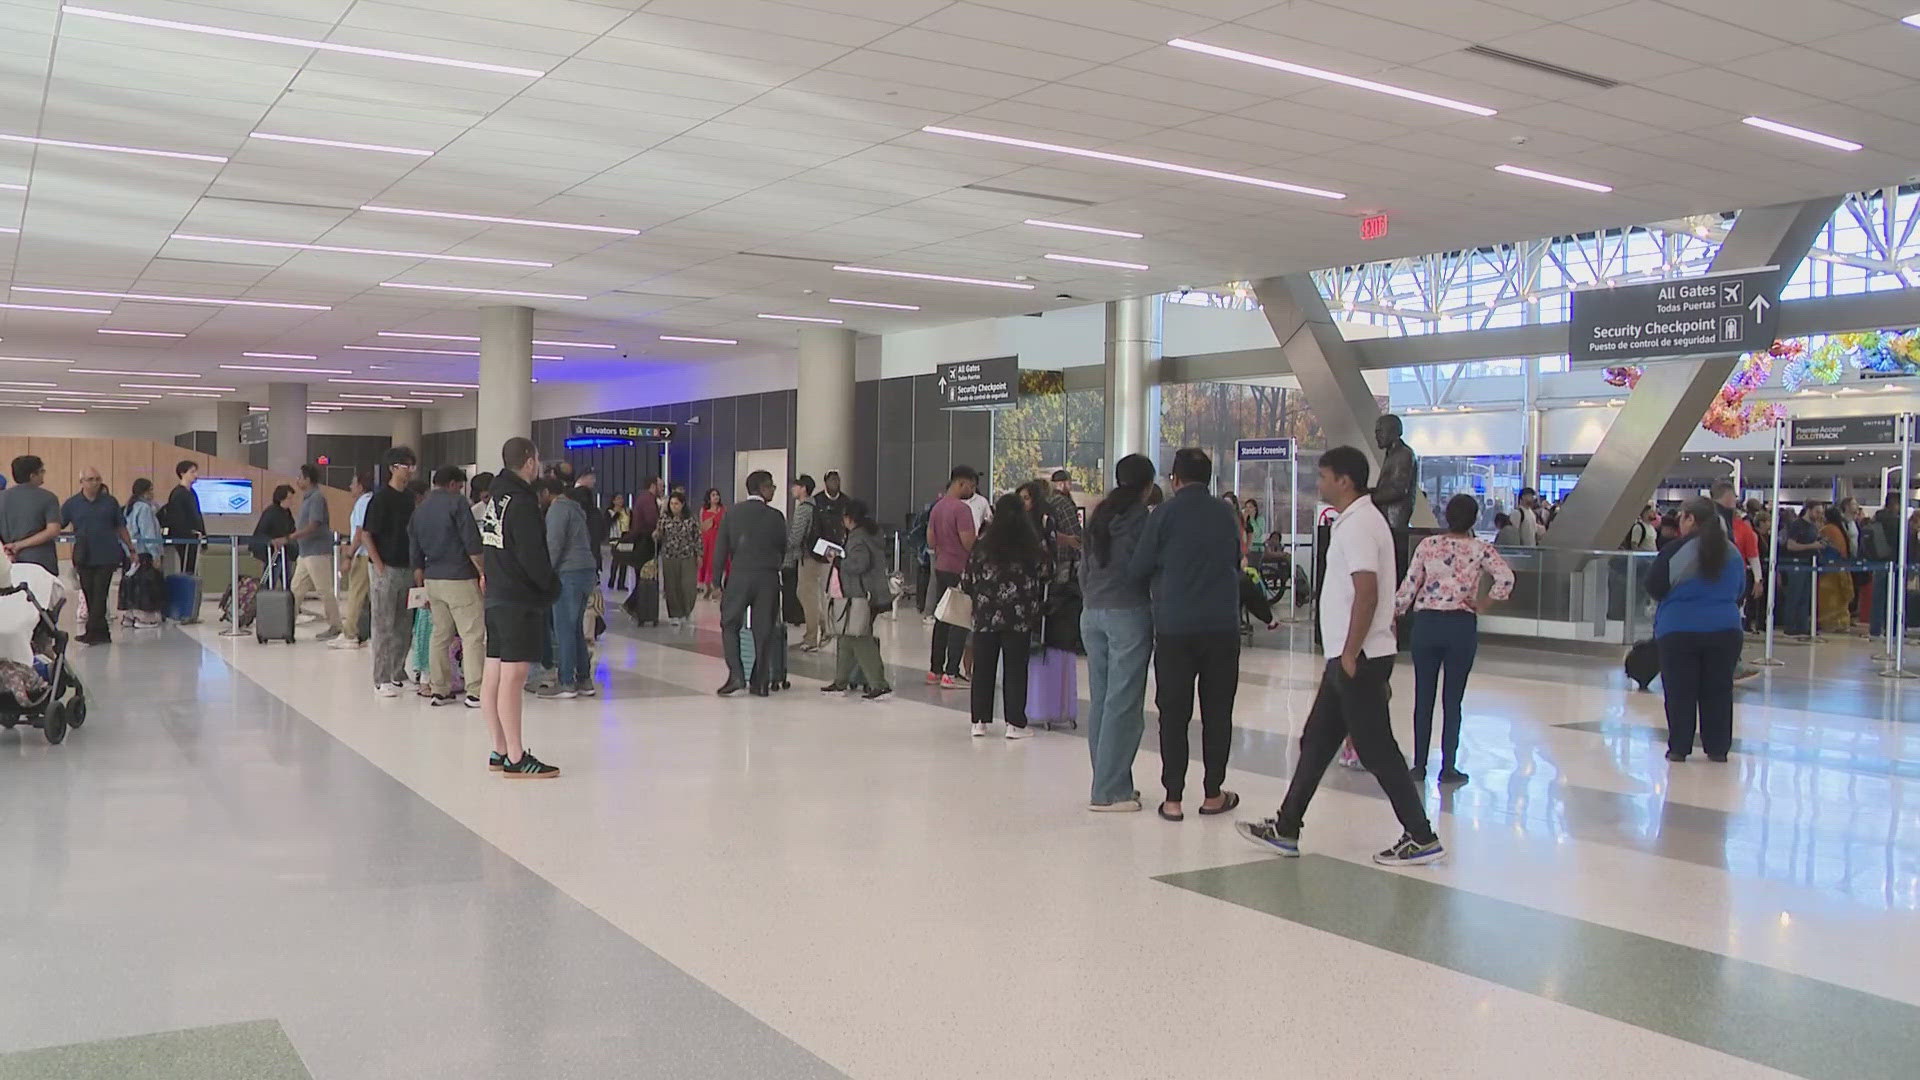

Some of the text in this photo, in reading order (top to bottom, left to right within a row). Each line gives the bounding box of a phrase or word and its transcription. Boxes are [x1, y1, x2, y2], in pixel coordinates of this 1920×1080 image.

[1364, 216, 1384, 238] EXIT
[1658, 285, 1716, 300] All Gates
[1656, 301, 1716, 314] Todas Puertas
[1593, 318, 1716, 339] Security Checkpoint
[1589, 335, 1716, 352] Puesto de control de seguridad
[957, 364, 980, 373] All Gates
[957, 382, 1007, 394] Security Checkpoint
[585, 427, 617, 435] Elevators
[1796, 432, 1839, 440] GOLDTRACK
[1241, 447, 1286, 456] Standard Screening
